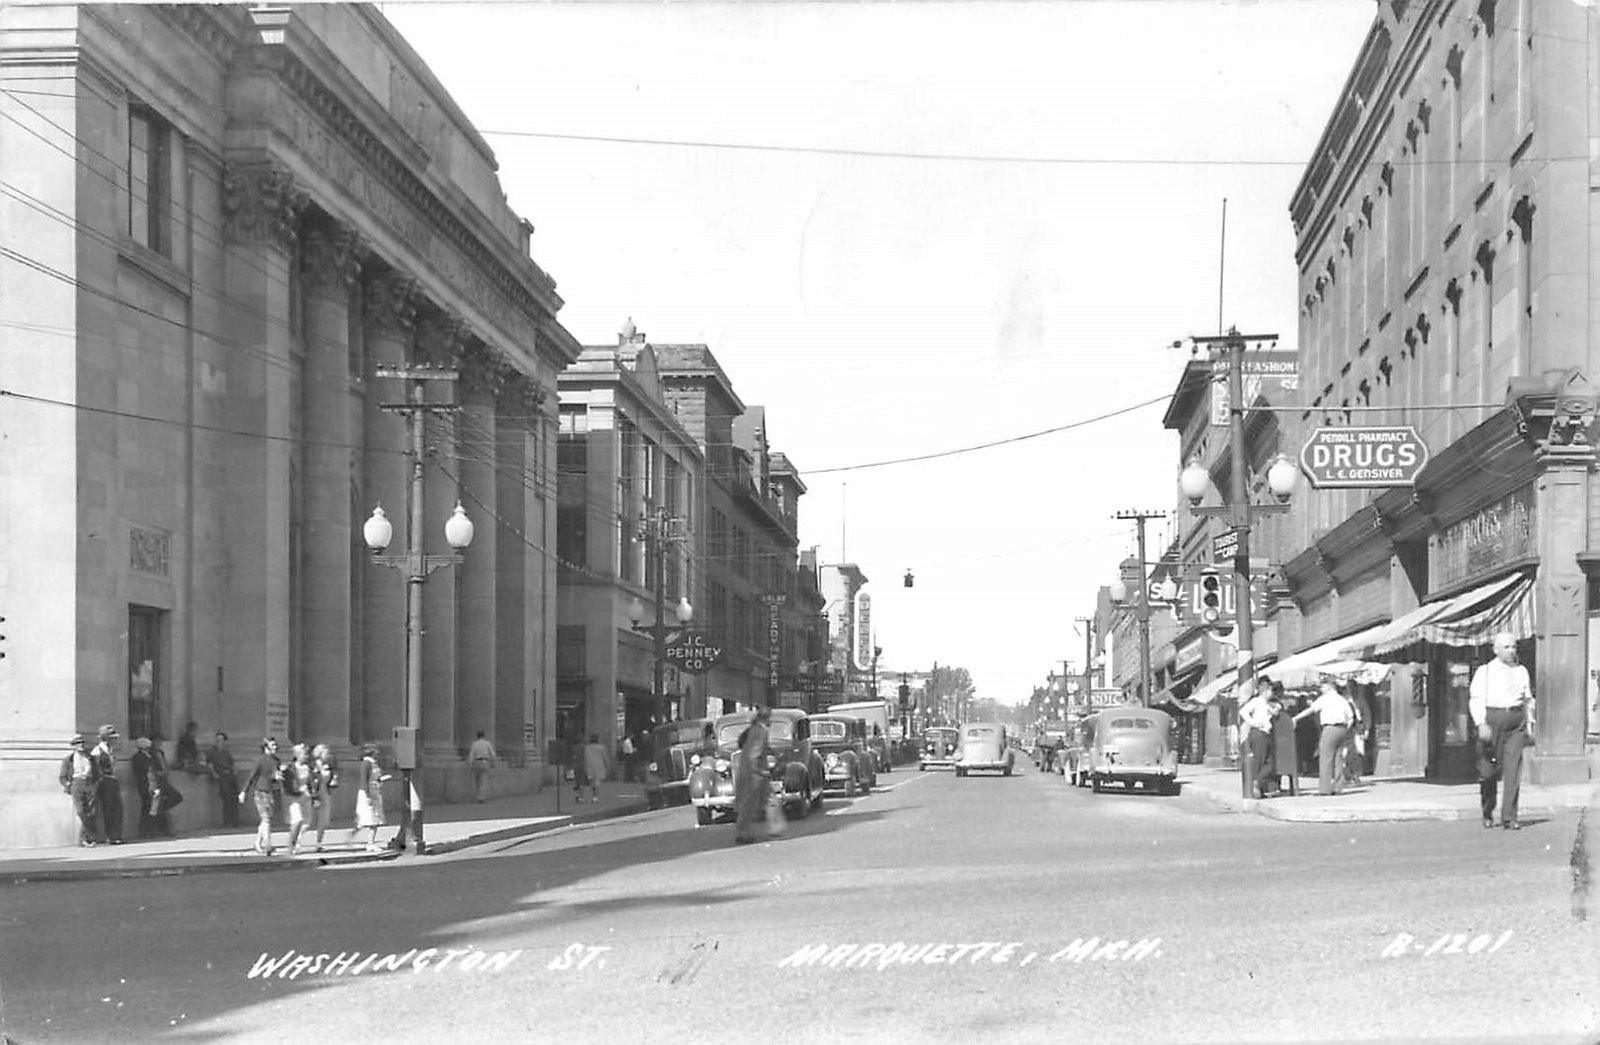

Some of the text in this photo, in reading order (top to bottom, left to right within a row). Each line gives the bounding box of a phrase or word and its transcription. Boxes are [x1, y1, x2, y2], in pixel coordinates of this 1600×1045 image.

[1321, 431, 1408, 443] PENDILL PHARMACY
[1313, 443, 1417, 468] DRUGS
[1349, 468, 1404, 479] GENSIVER
[667, 647, 721, 658] PENNEY
